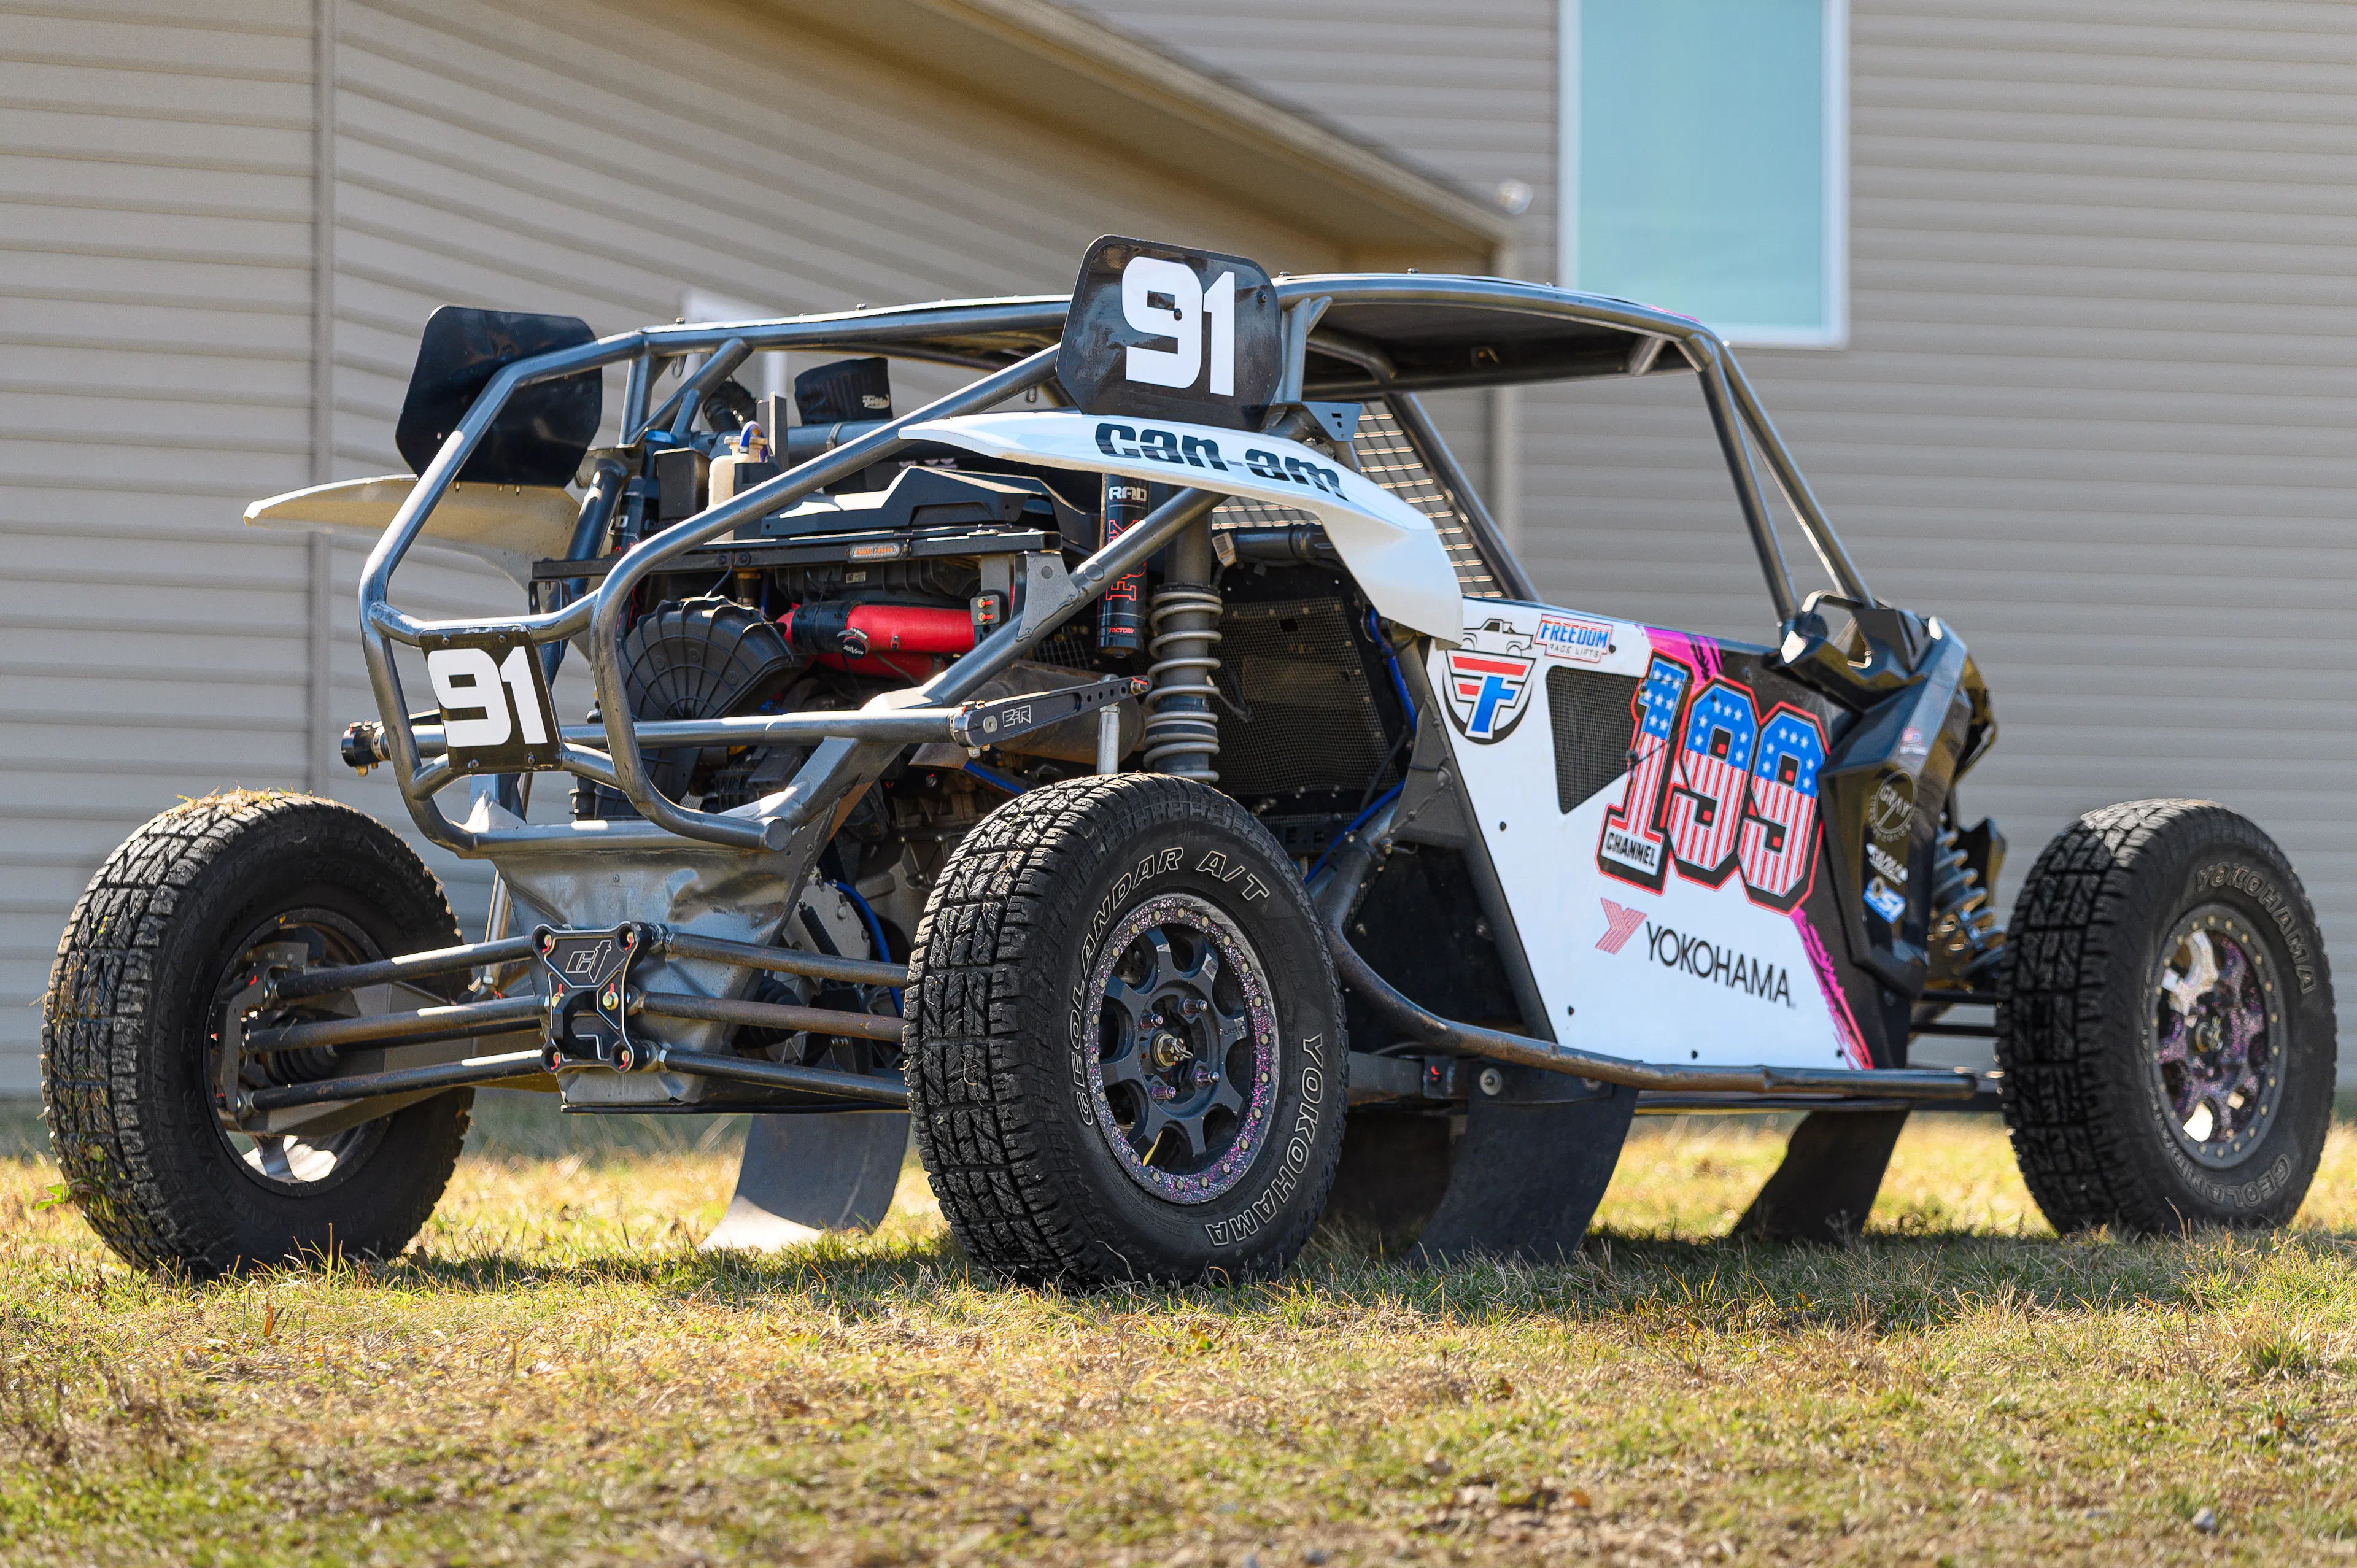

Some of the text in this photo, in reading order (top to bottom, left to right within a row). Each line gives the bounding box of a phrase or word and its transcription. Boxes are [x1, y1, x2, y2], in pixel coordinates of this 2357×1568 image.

[1122, 256, 1235, 396] 91
[1095, 423, 1349, 502] can-am
[1540, 622, 1609, 649] FREEDOM
[427, 646, 548, 748] 91
[1606, 655, 1827, 898] 199
[1606, 831, 1657, 870] CHANNEL
[1070, 846, 1184, 1127] GEOLANDAR
[1195, 847, 1271, 902] A/T
[1646, 921, 1793, 1008] YOKOHAMA
[2196, 860, 2318, 995] YOKOHAMA
[1205, 1032, 1324, 1248] YOKOHAMA
